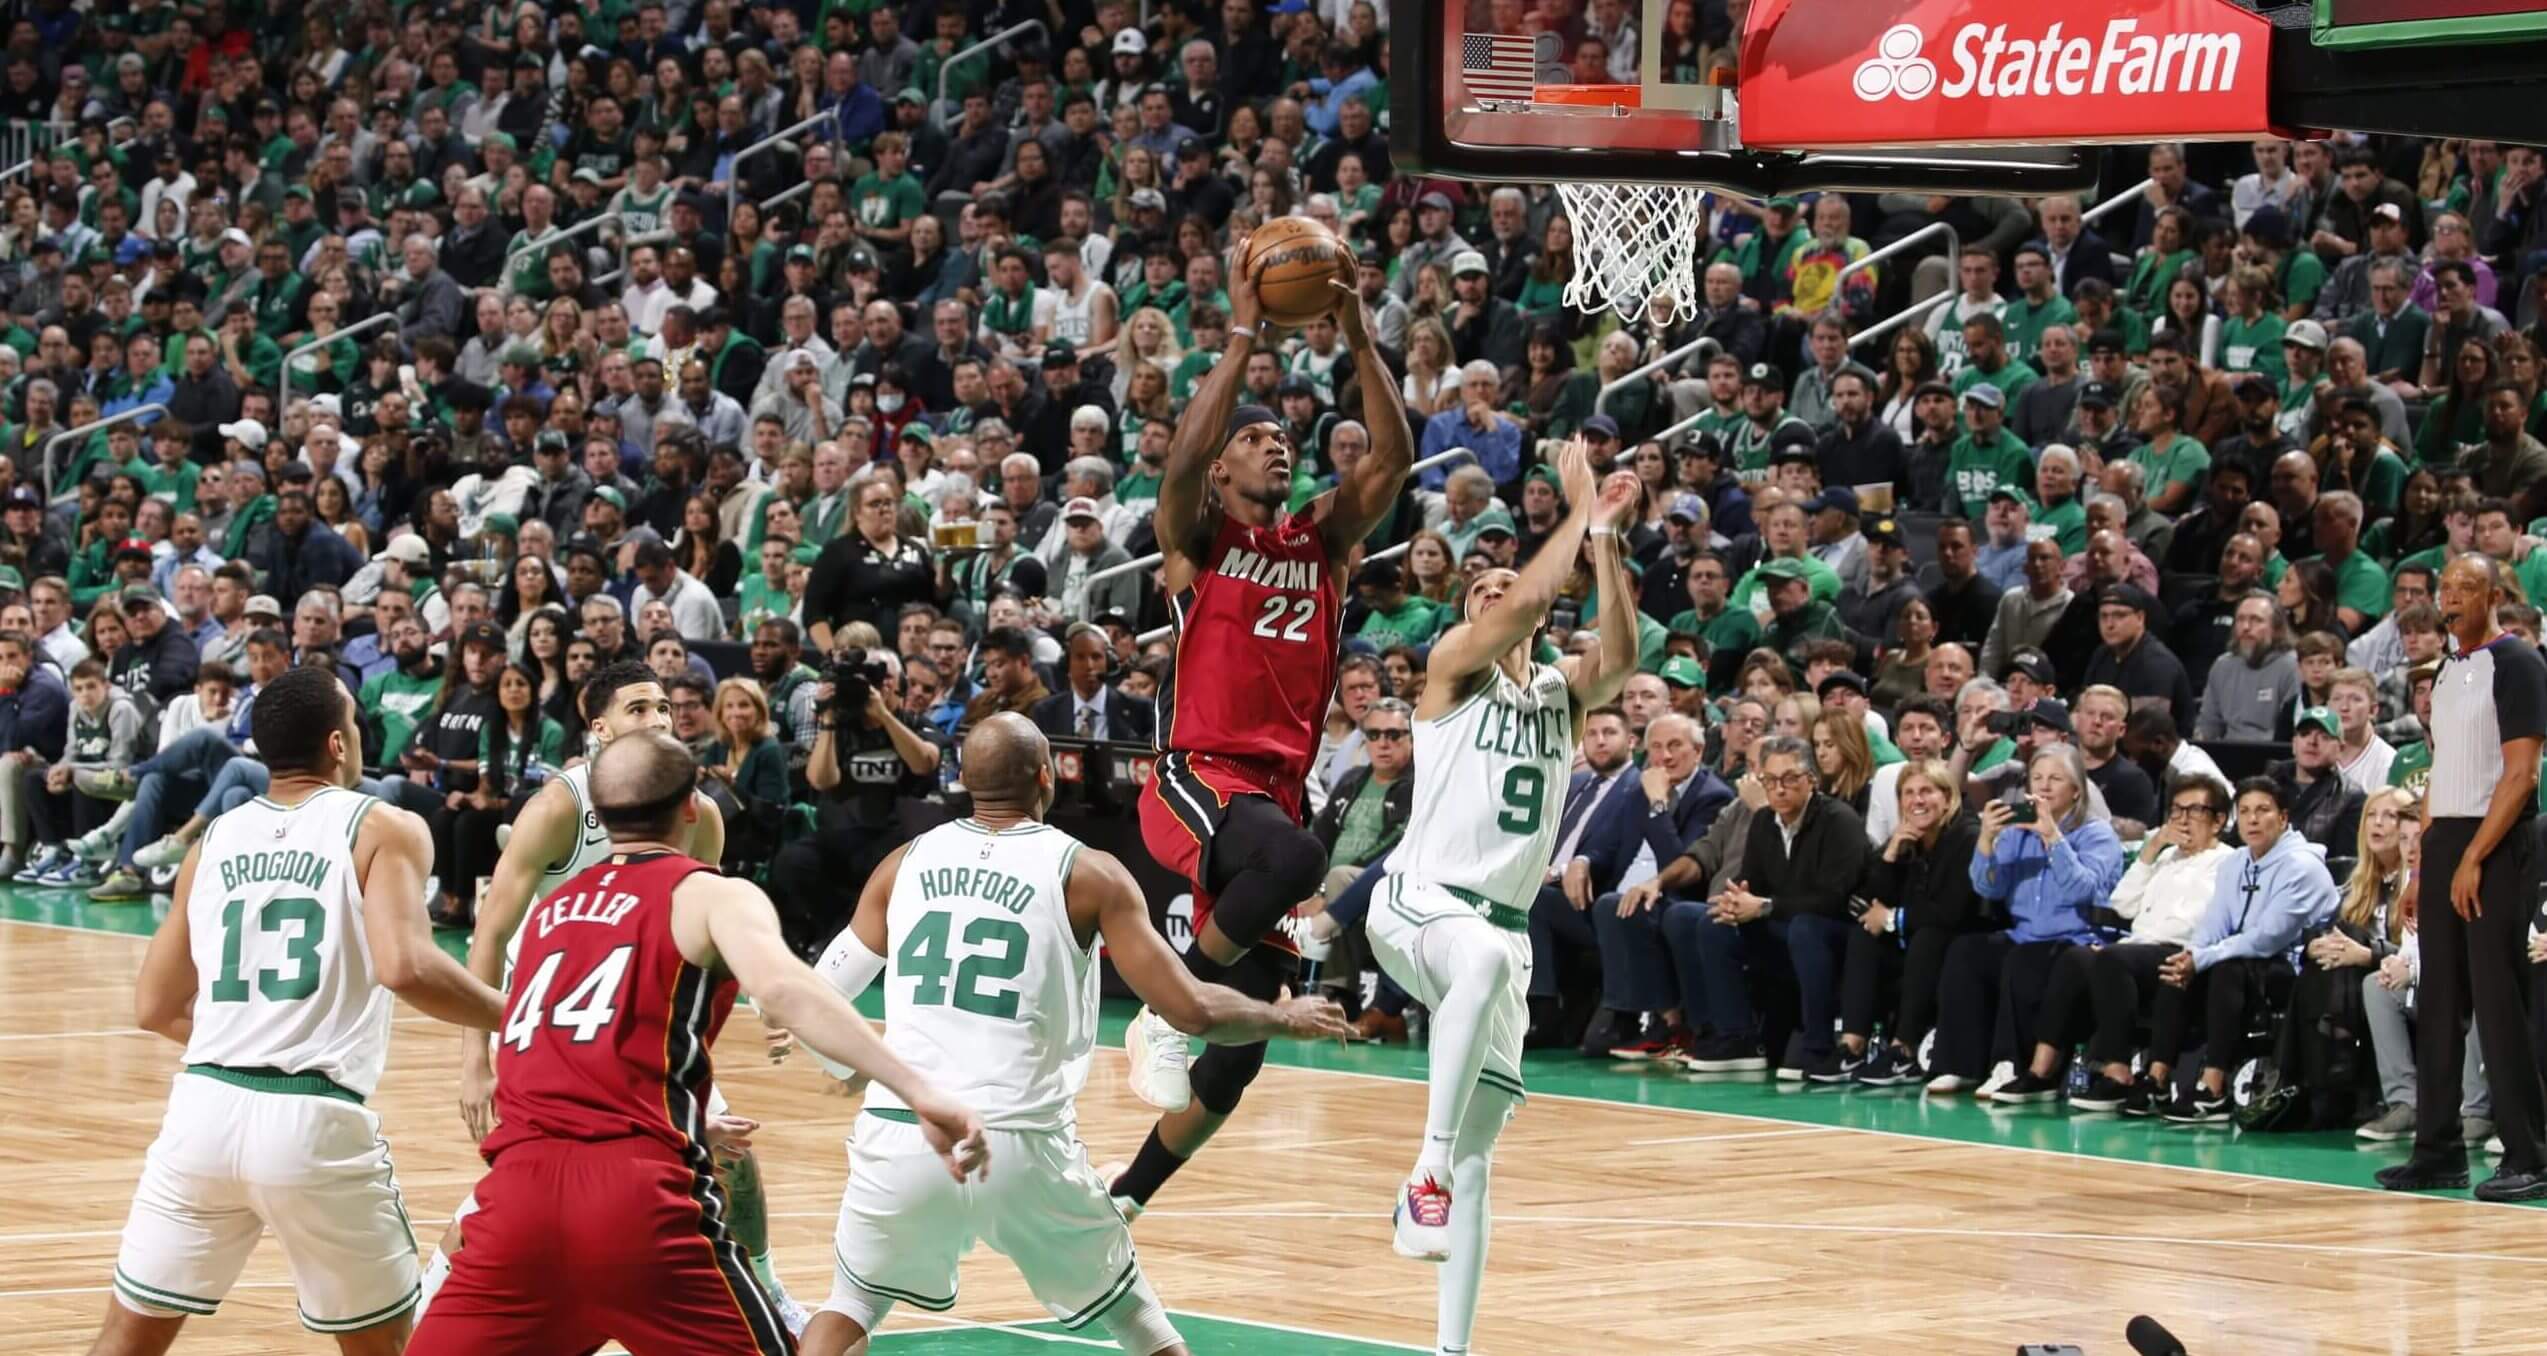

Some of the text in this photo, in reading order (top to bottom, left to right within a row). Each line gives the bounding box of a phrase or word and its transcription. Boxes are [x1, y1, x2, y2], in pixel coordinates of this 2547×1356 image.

[1941, 18, 2241, 99] State Farm
[1217, 547, 1319, 592] MIAMI
[1253, 595, 1316, 642] 22
[1497, 765, 1544, 835] 9
[220, 849, 331, 892] BROGDON
[920, 867, 1035, 914] HORFORD
[537, 891, 640, 939] ZELLER
[1167, 914, 1194, 937] TN
[212, 898, 326, 1002] 13
[897, 911, 1029, 1020] 42
[504, 945, 634, 1053] 44
